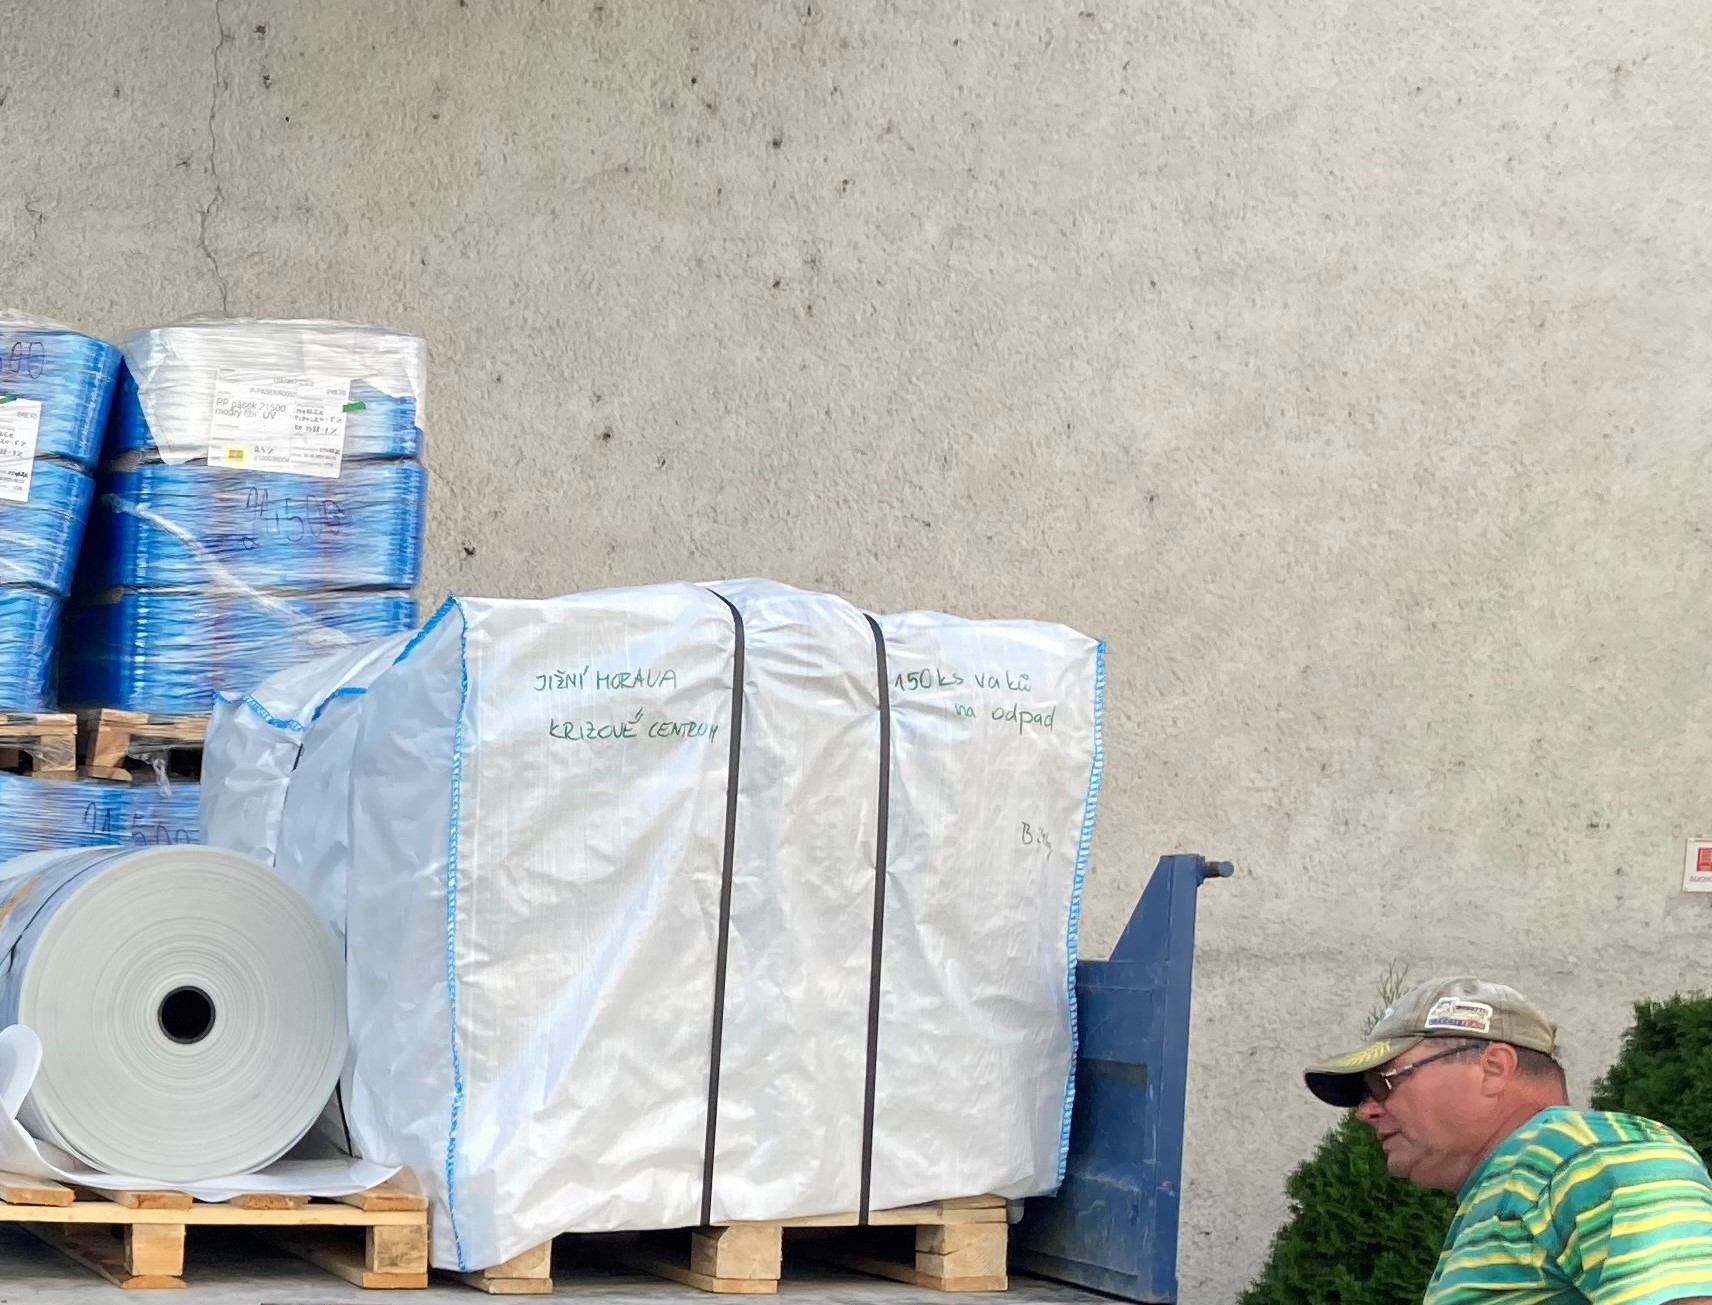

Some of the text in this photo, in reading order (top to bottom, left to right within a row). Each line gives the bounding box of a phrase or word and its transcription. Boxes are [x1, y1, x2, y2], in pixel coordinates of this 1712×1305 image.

[216, 398, 230, 408] PP
[262, 411, 276, 420] UV
[596, 667, 677, 690] MORAVA
[954, 702, 1057, 736] na odpad
